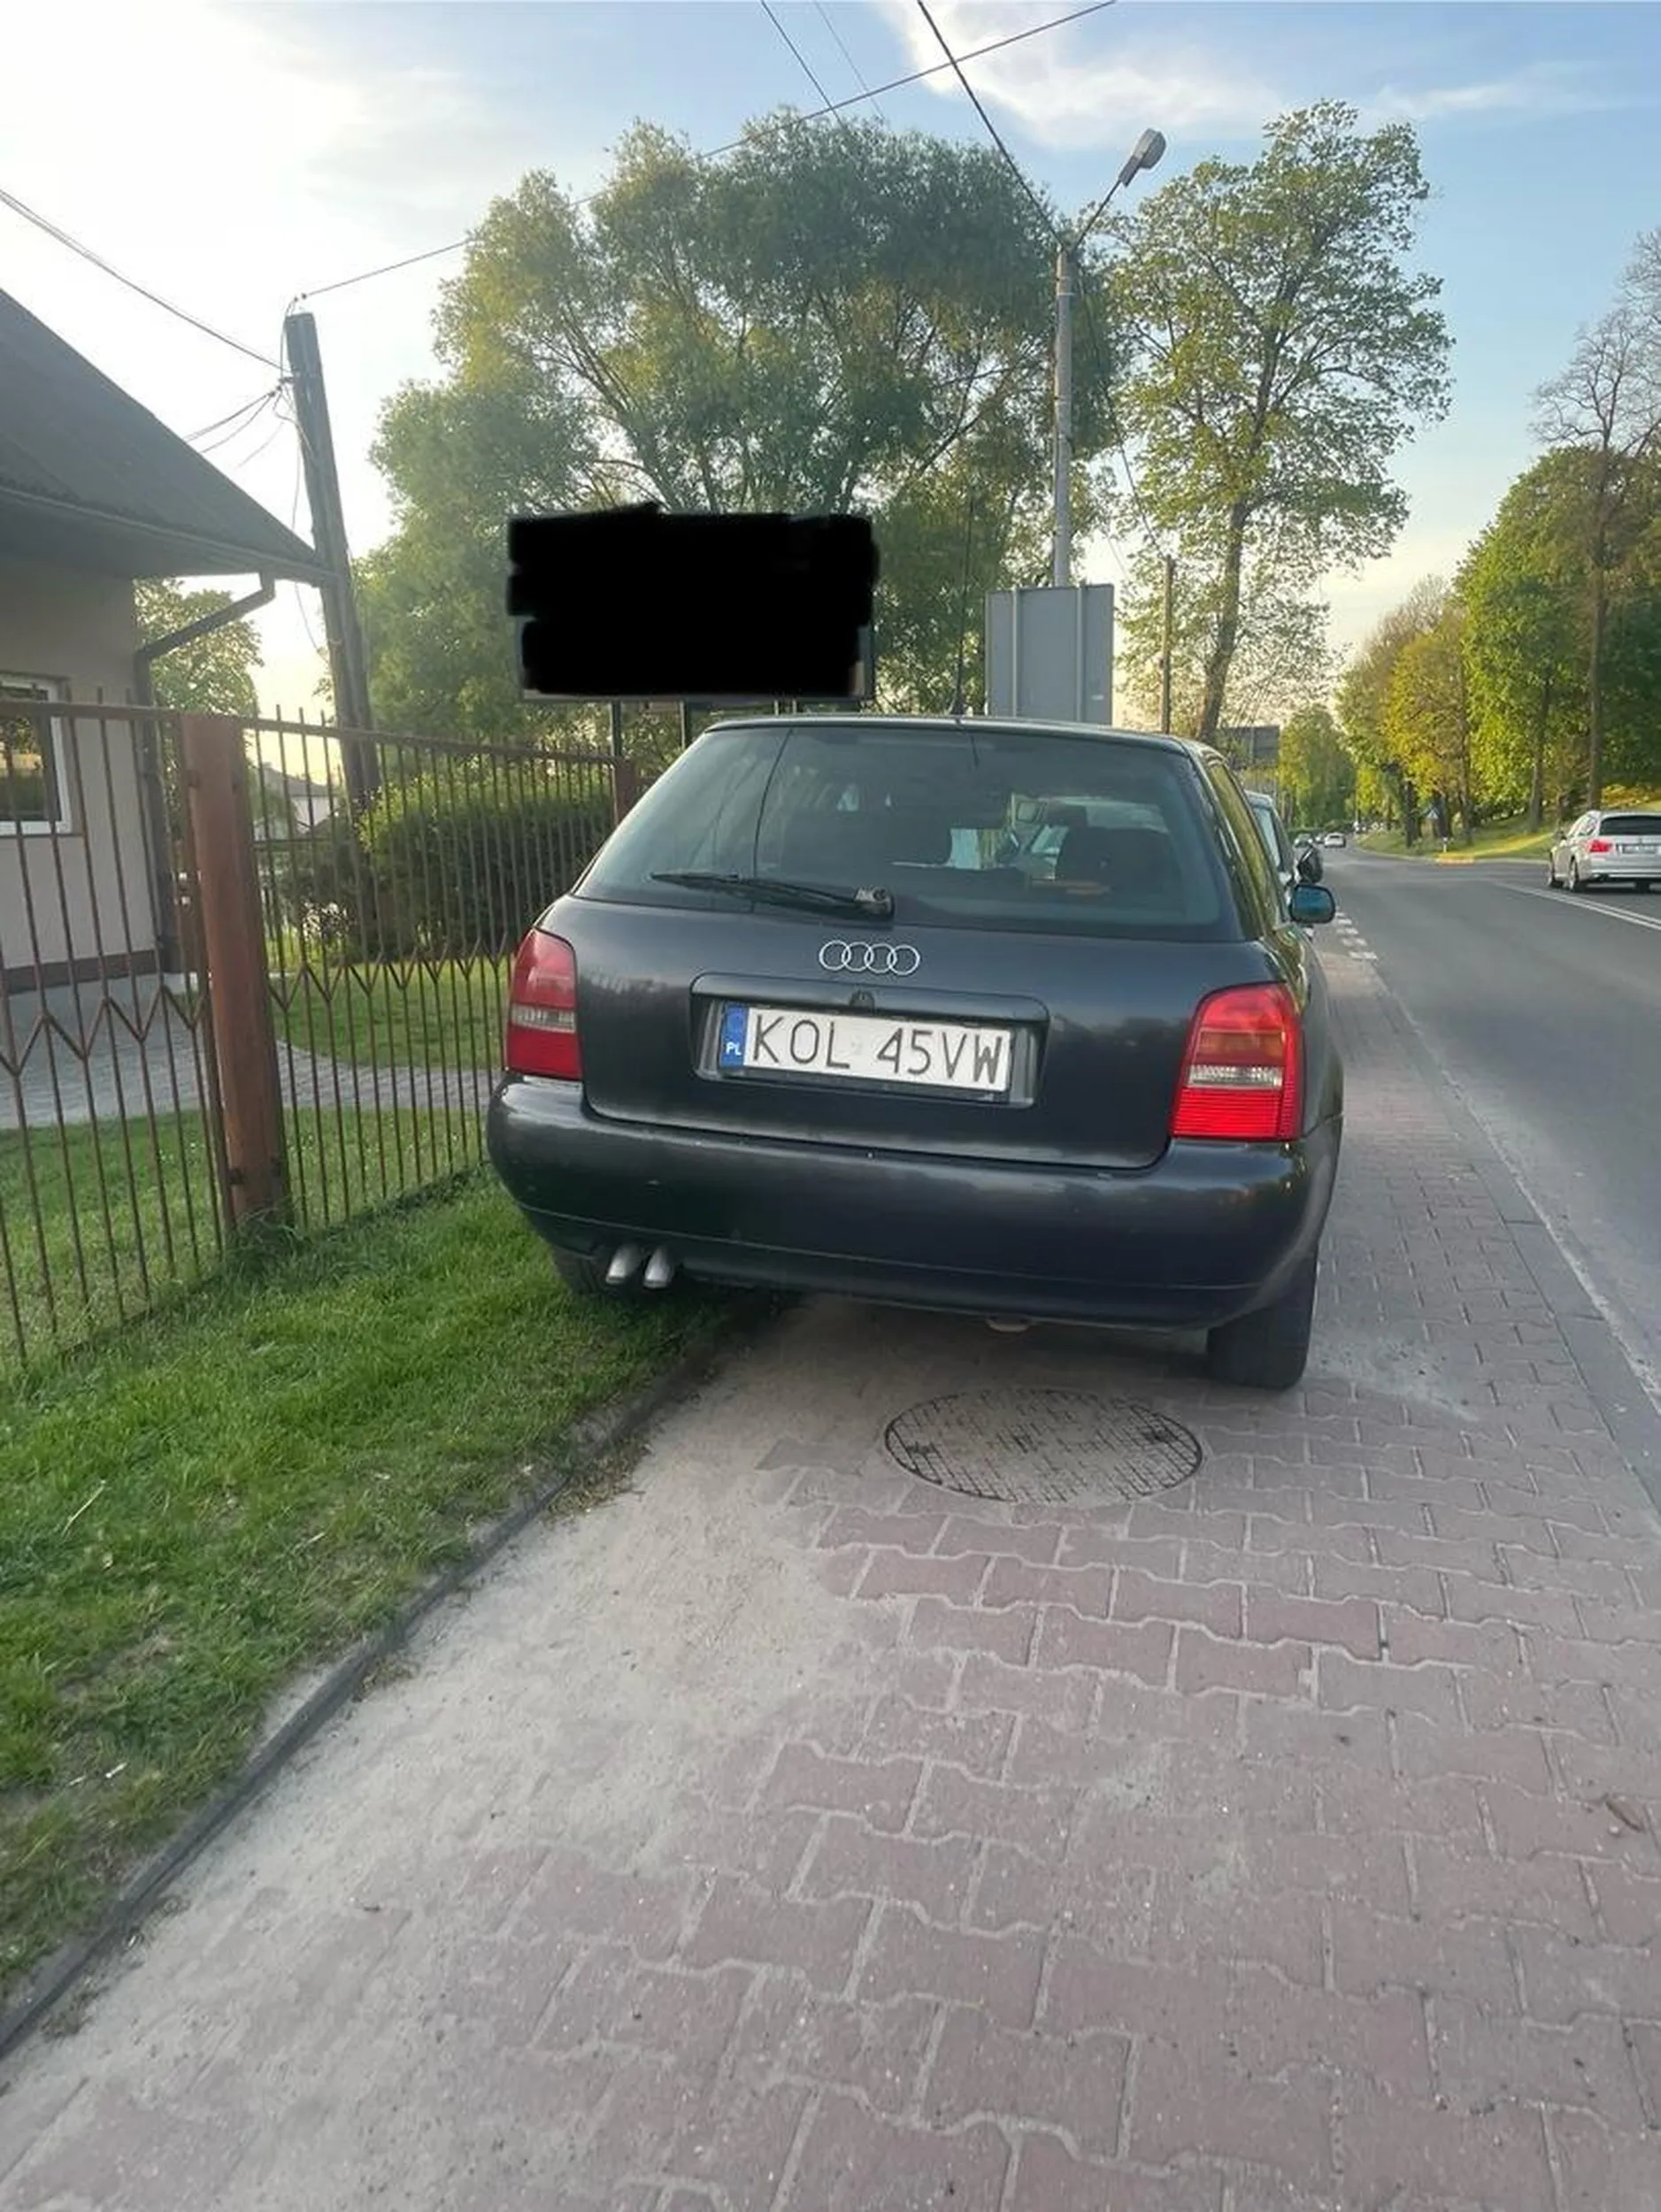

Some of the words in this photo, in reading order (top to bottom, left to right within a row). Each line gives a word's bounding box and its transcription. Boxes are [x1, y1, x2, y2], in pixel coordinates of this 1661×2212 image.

[726, 1041, 742, 1056] PL
[753, 1014, 850, 1069] KOL
[877, 1027, 1004, 1084] 45VW
